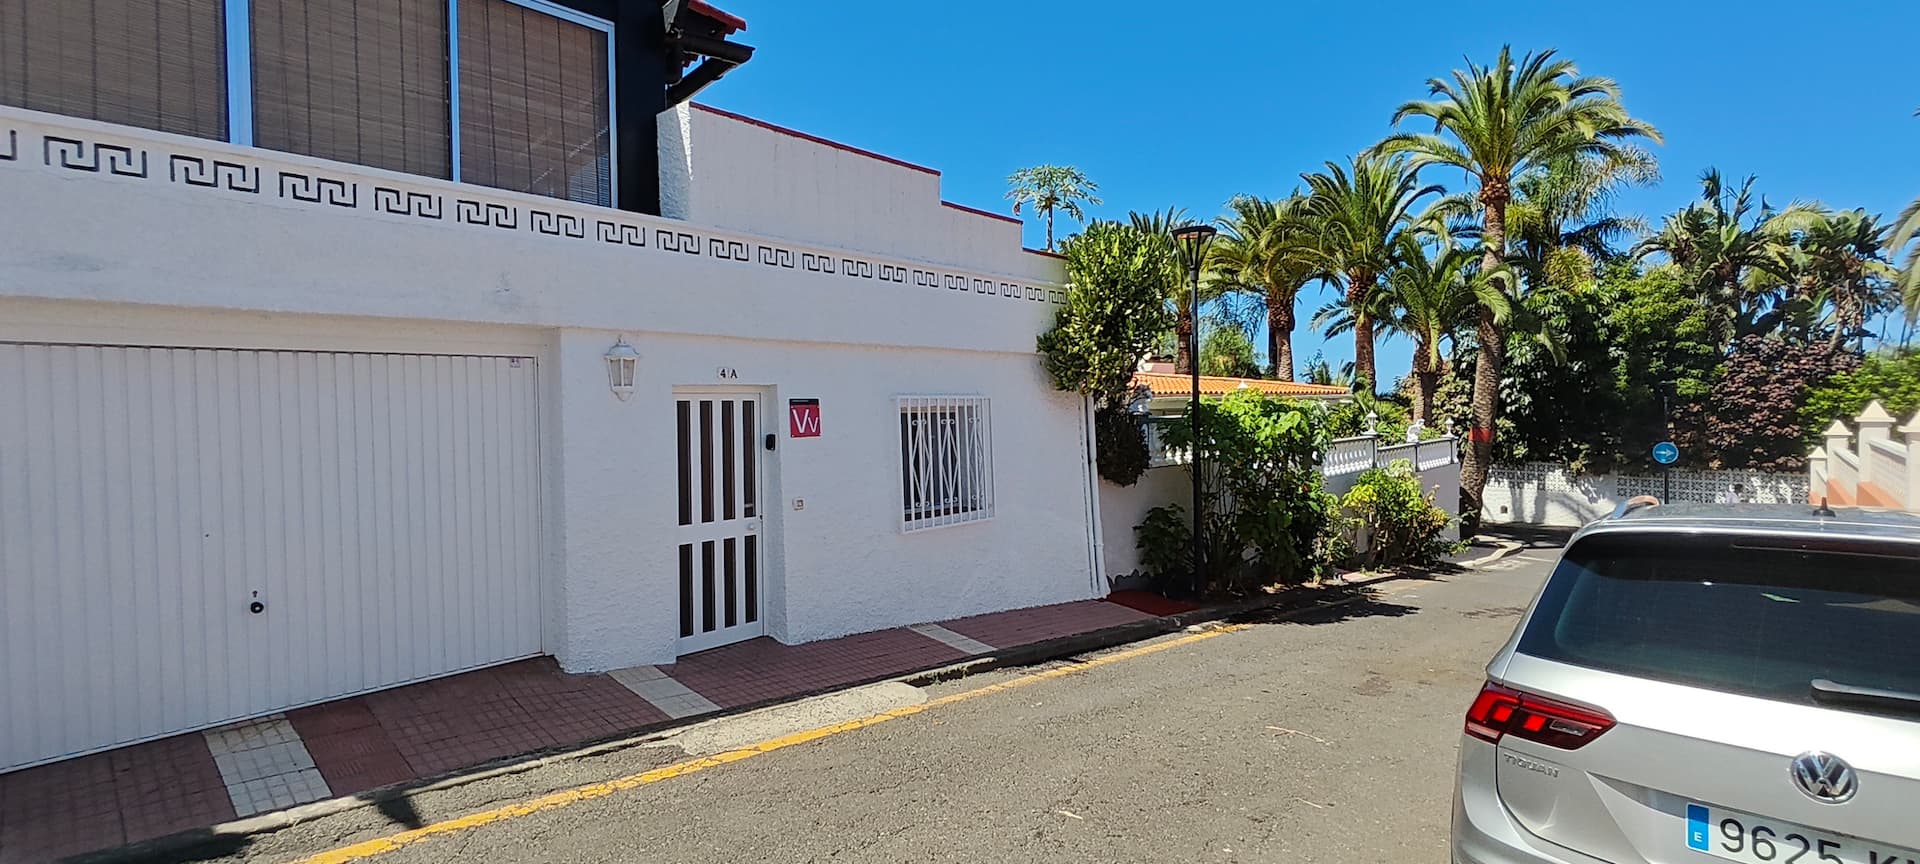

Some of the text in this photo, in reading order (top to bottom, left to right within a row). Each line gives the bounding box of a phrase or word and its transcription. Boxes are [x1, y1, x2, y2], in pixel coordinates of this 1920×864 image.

[1503, 752, 1560, 778] TIGUAN
[1694, 831, 1703, 842] E
[1720, 818, 1843, 864] 9625
